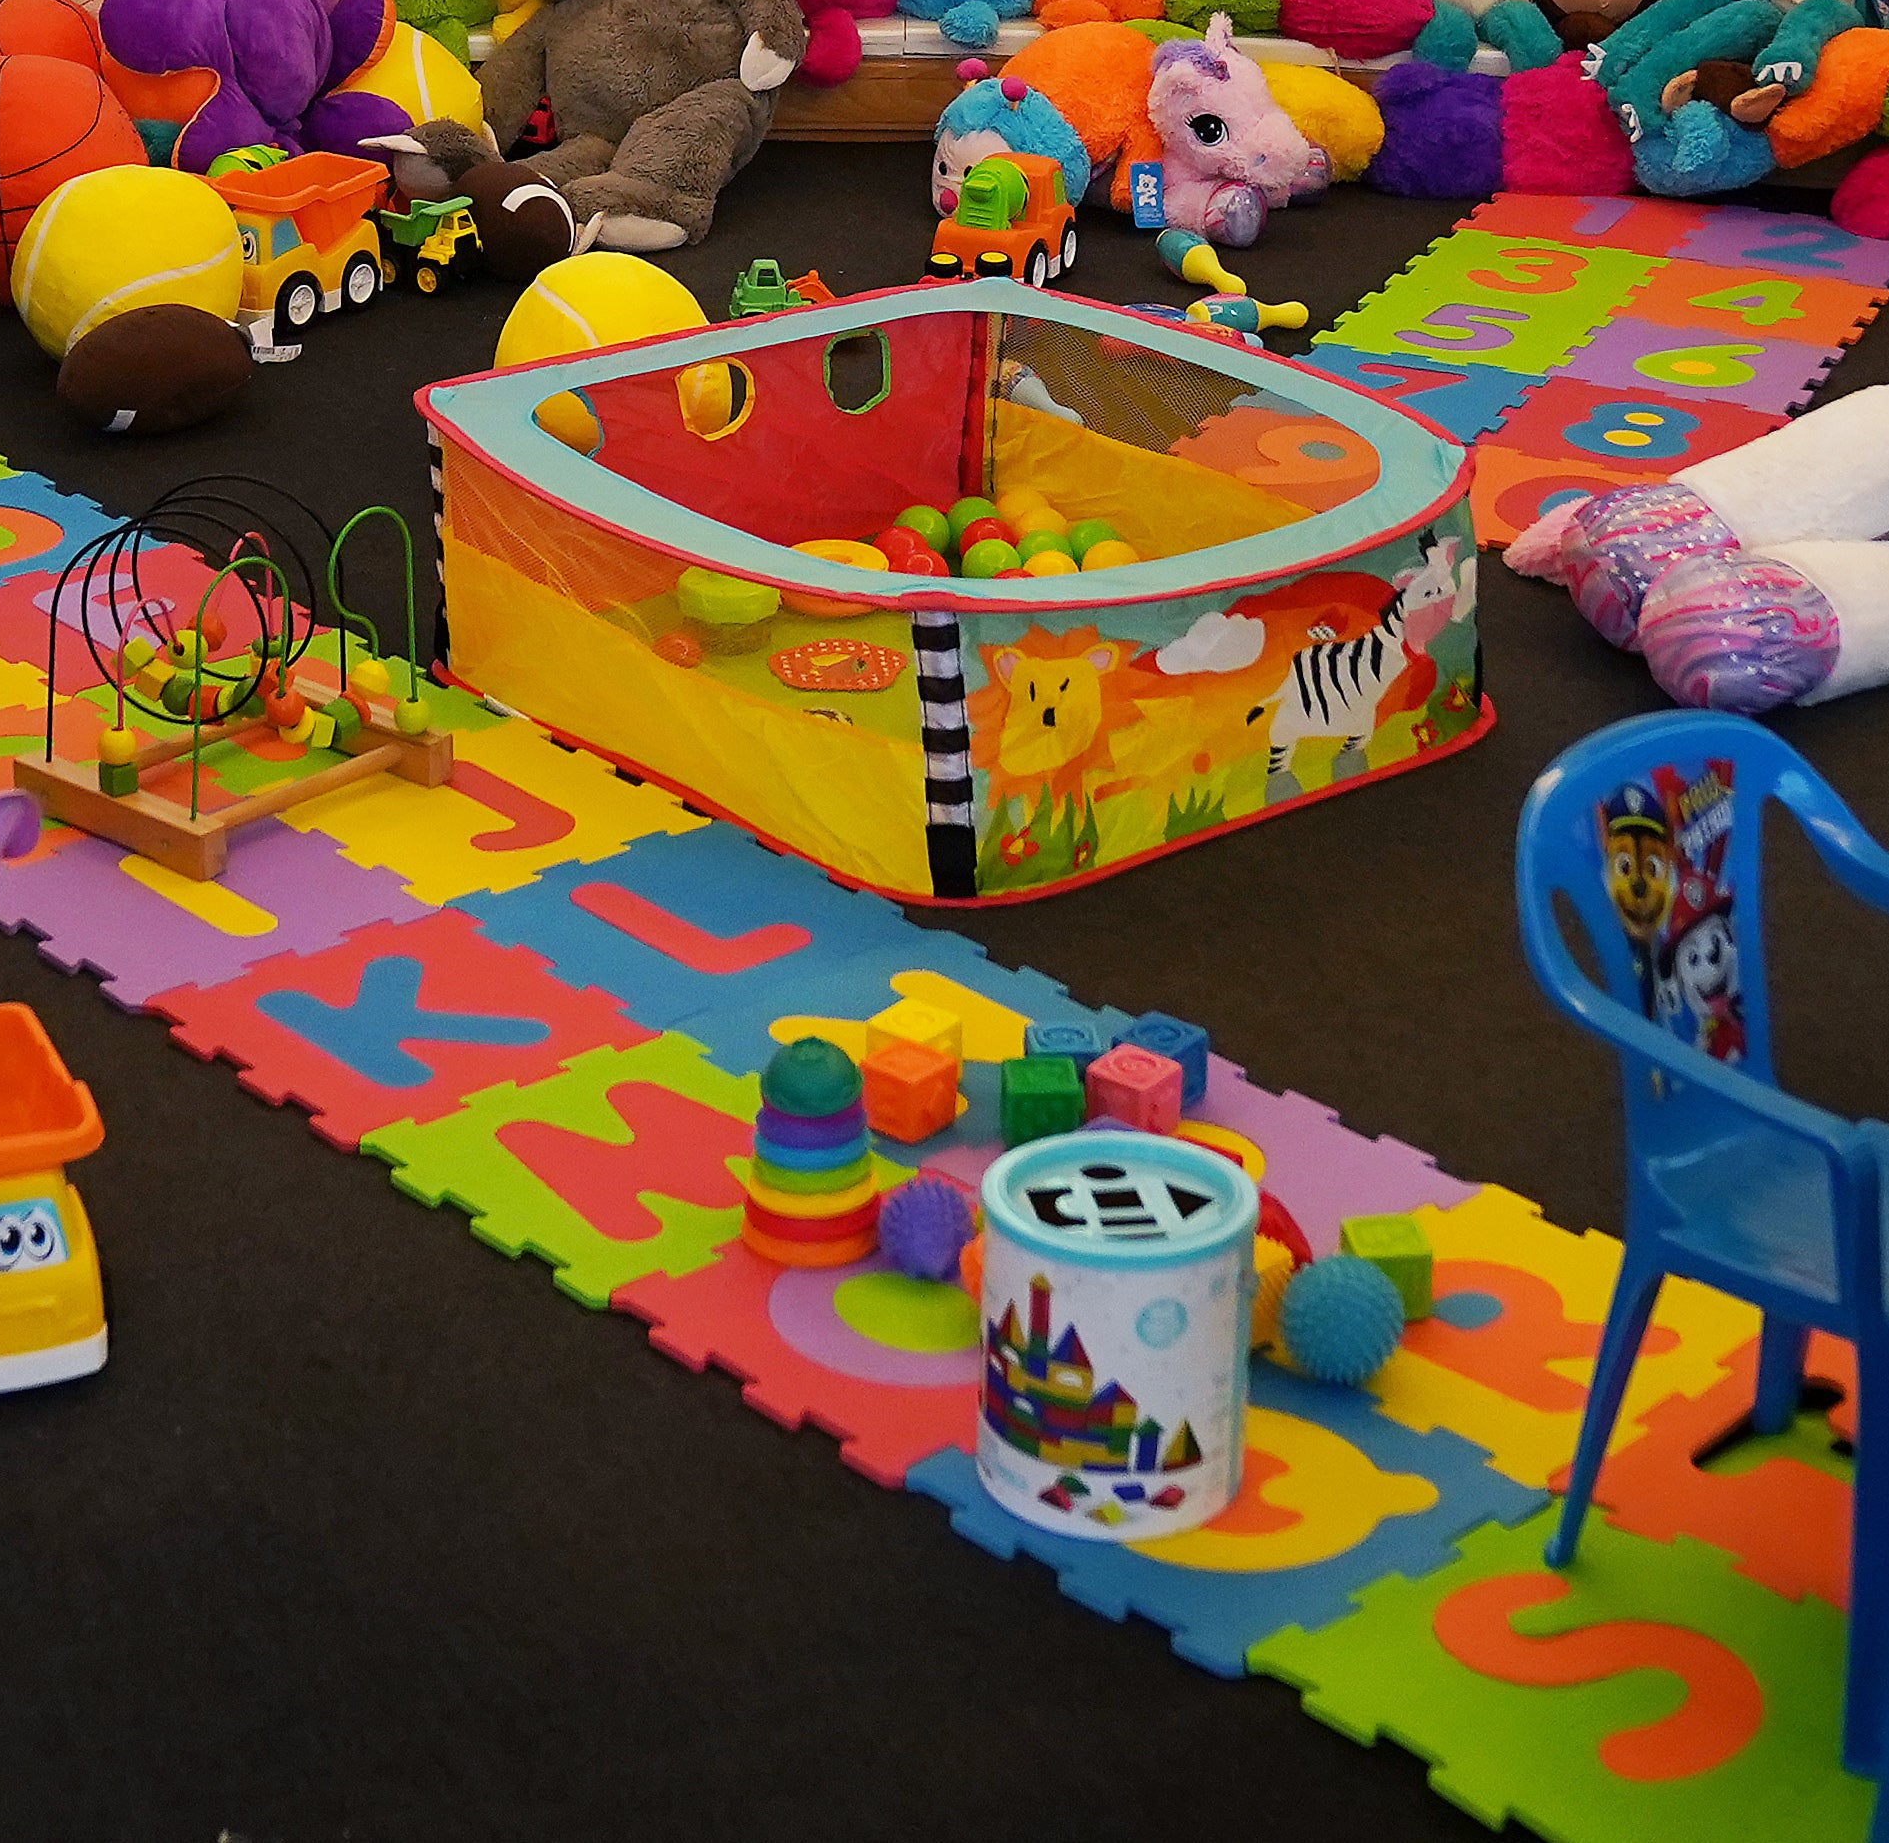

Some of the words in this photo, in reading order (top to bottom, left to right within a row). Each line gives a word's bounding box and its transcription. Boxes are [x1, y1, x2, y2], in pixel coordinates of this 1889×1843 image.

[1571, 197, 1642, 236] 1
[1740, 224, 1862, 269] 2
[1467, 247, 1589, 295] 3
[1393, 303, 1531, 351] 5
[1687, 279, 1807, 327] 4
[1632, 343, 1768, 388] 6
[1561, 401, 1701, 458] 8
[569, 882, 813, 976] L
[255, 955, 552, 1090] K
[1433, 1570, 1765, 1783] S
